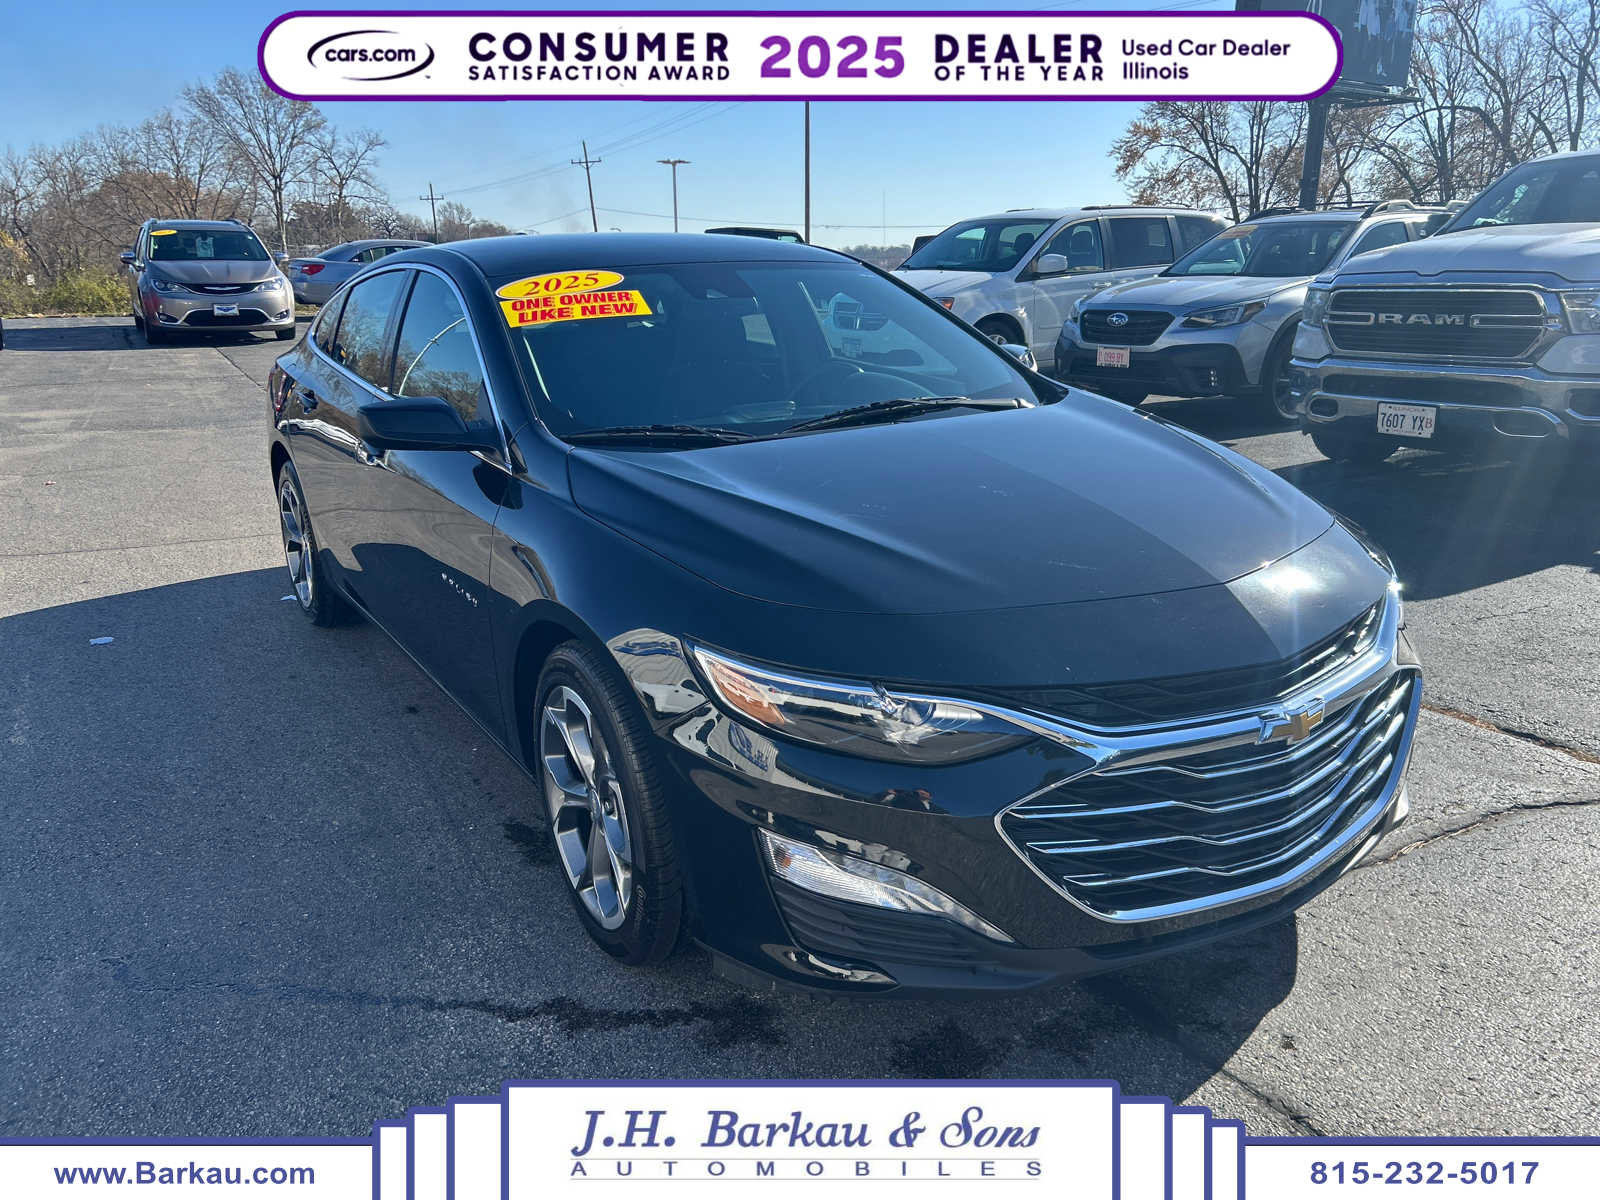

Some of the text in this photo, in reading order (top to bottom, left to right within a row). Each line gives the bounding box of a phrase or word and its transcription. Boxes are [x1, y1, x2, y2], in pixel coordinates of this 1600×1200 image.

[522, 272, 600, 297] 2025
[511, 291, 632, 312] ONE OWNER
[518, 302, 637, 324] LIKE NEW
[1378, 313, 1465, 325] RAM
[1381, 412, 1405, 429] 7607
